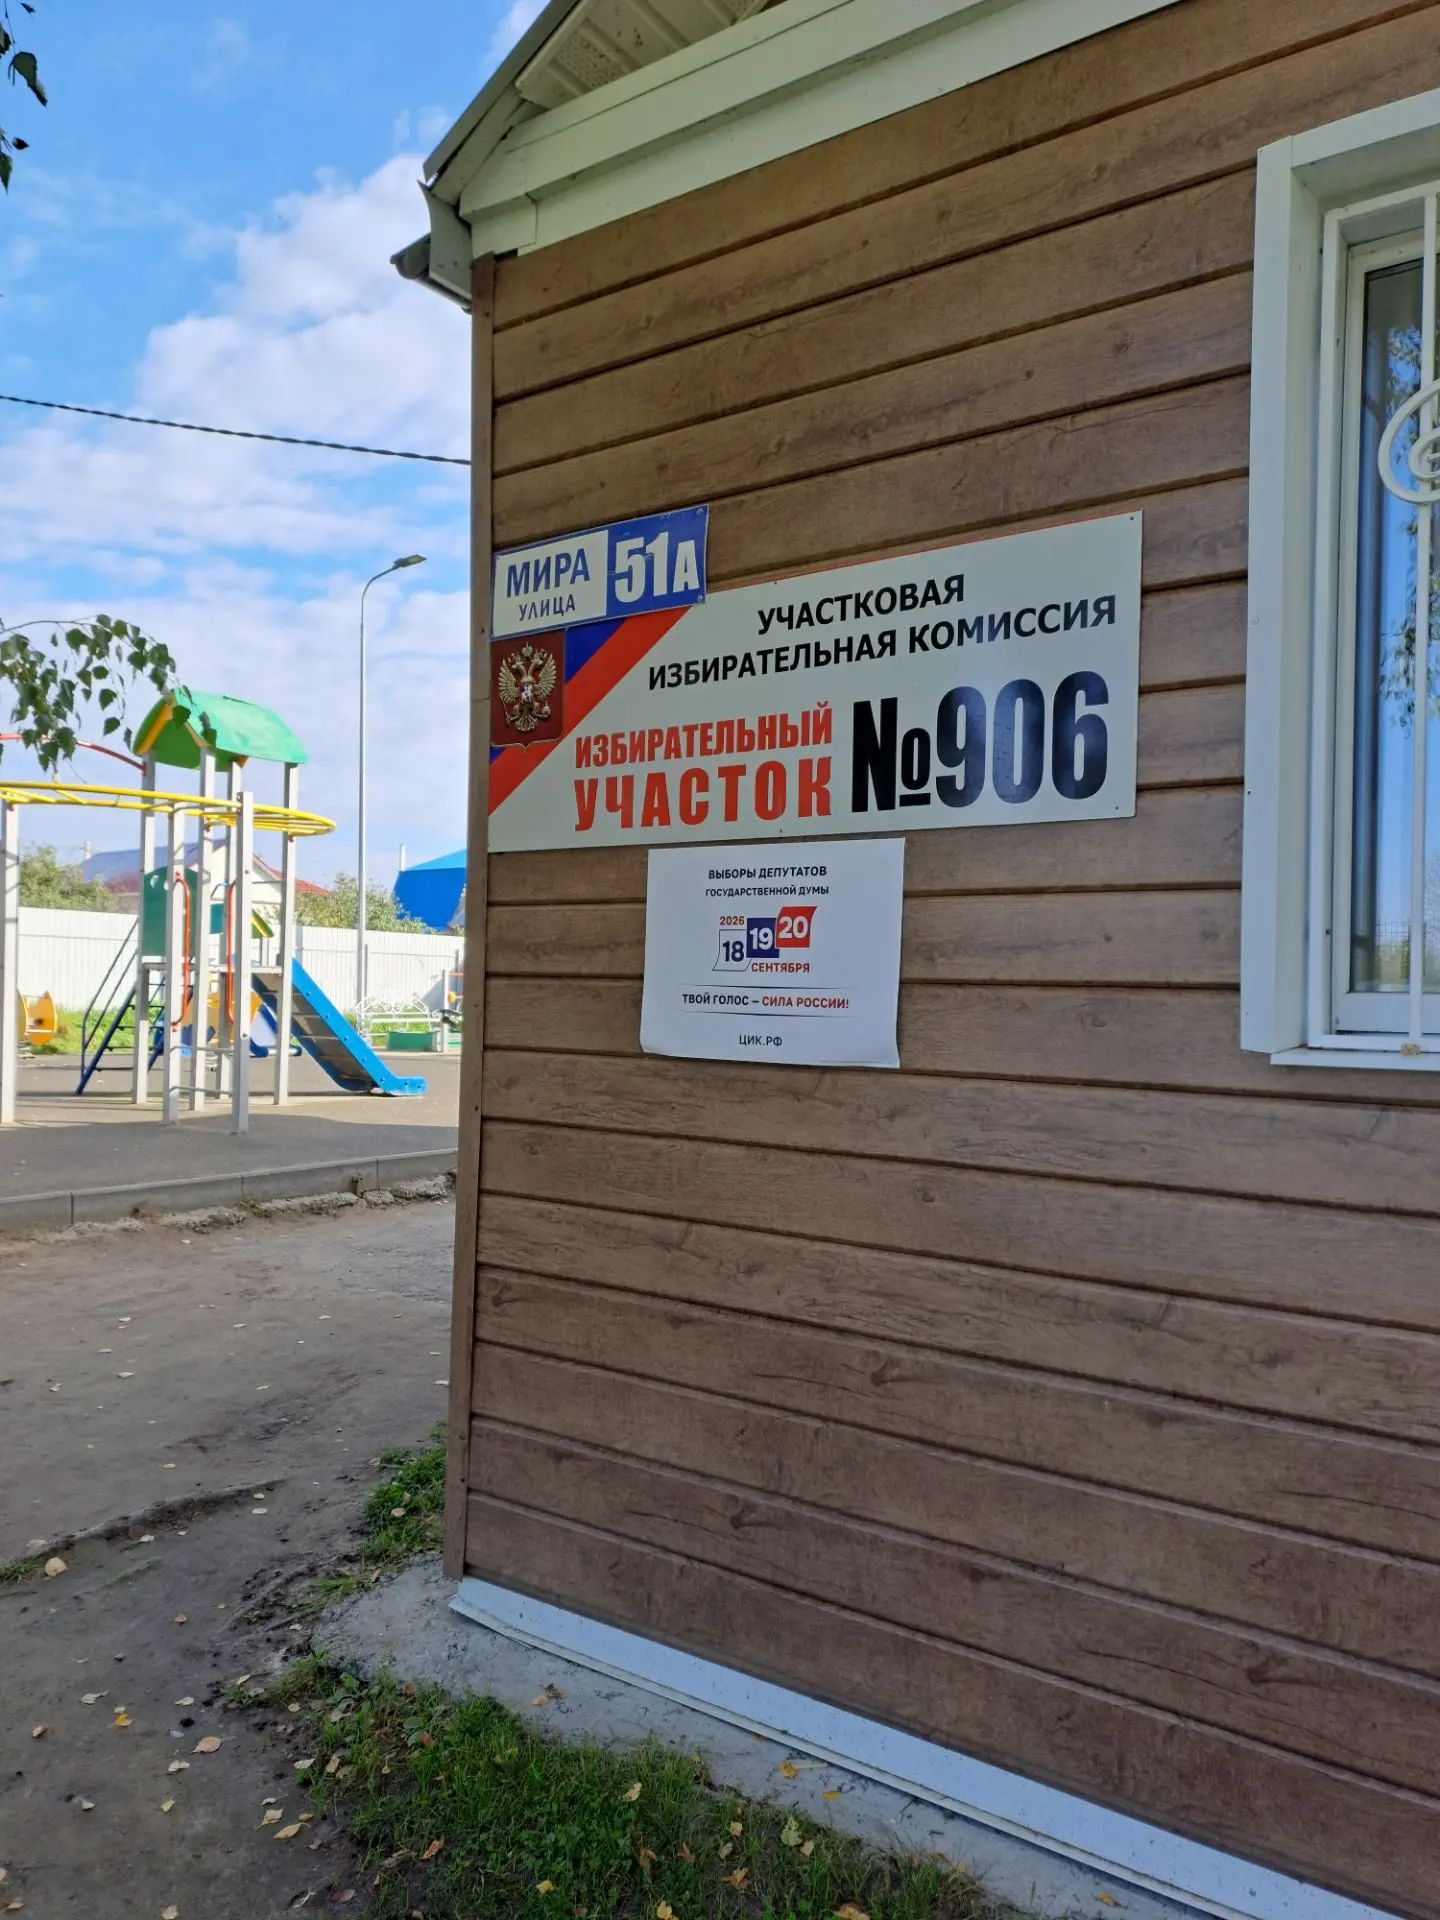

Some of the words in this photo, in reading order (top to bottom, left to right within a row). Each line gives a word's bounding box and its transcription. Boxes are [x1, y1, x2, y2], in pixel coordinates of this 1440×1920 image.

[506, 548, 590, 598] МИРА
[614, 531, 699, 603] 51А
[518, 594, 576, 622] УЛИЦА
[757, 574, 965, 635] УЧАСТКОВАЯ
[648, 629, 897, 690] ИЗБИРАТЕЛЬНАЯ
[908, 594, 1117, 654] КОМИССИЯ
[575, 701, 833, 769] ИЗБИРАТЕЛЬНЫЙ
[852, 671, 1110, 813] №906
[573, 756, 833, 833] УЧАСТОК
[705, 884, 796, 897] ГОСУДАРСТВЕННОЙ
[798, 886, 829, 896] ДУМЫ
[708, 868, 756, 879] ВЫБОРЫ
[758, 866, 827, 879] ДЕПУТАТОВ
[719, 915, 745, 926] 2026
[722, 940, 744, 962] 18
[749, 927, 773, 950] 19
[778, 915, 809, 939] 20
[751, 963, 810, 973] СЕНТЯБРЯ
[682, 992, 711, 1005] ТВОЙ
[712, 994, 749, 1006] ГОЛОС
[762, 996, 793, 1007] СИЛА
[796, 997, 849, 1009] РОССИИ!
[739, 1034, 783, 1047] ЦИК.РФ
